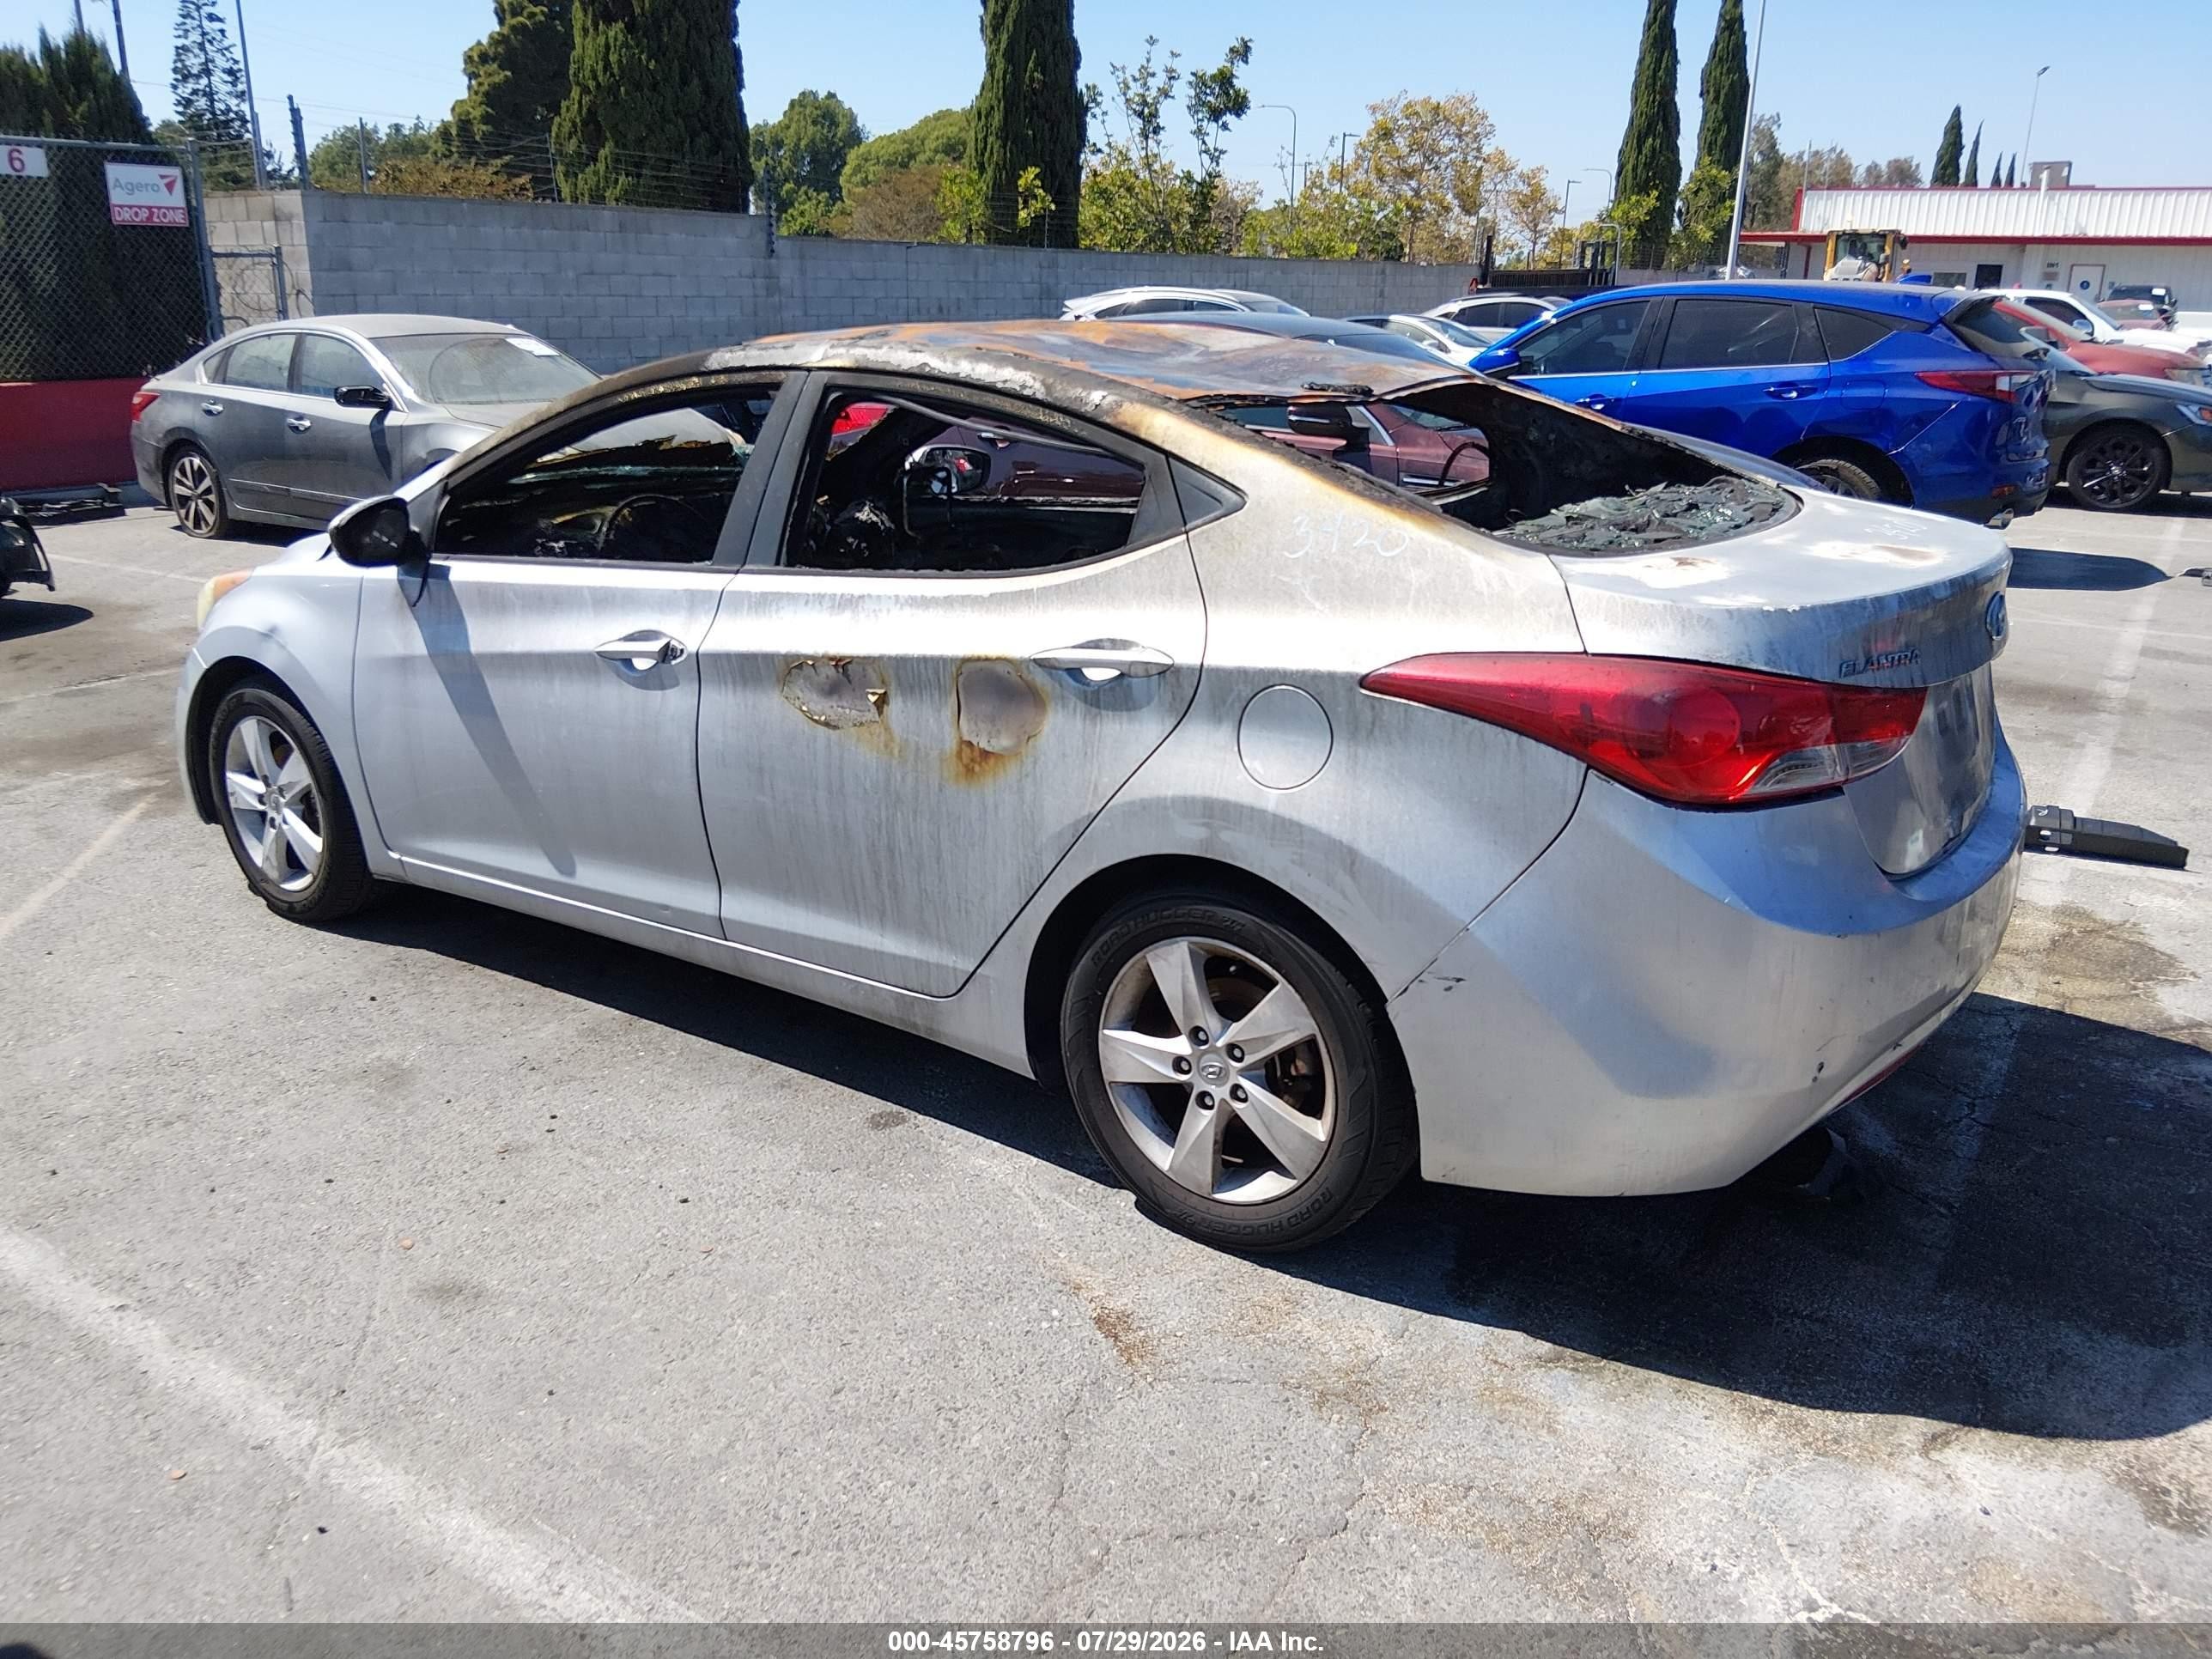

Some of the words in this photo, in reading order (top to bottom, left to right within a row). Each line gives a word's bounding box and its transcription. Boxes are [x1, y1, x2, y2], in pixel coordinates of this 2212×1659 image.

[8, 148, 26, 173] 6
[112, 178, 161, 196] Agero
[113, 207, 149, 222] DROP
[152, 209, 186, 223] ZONE
